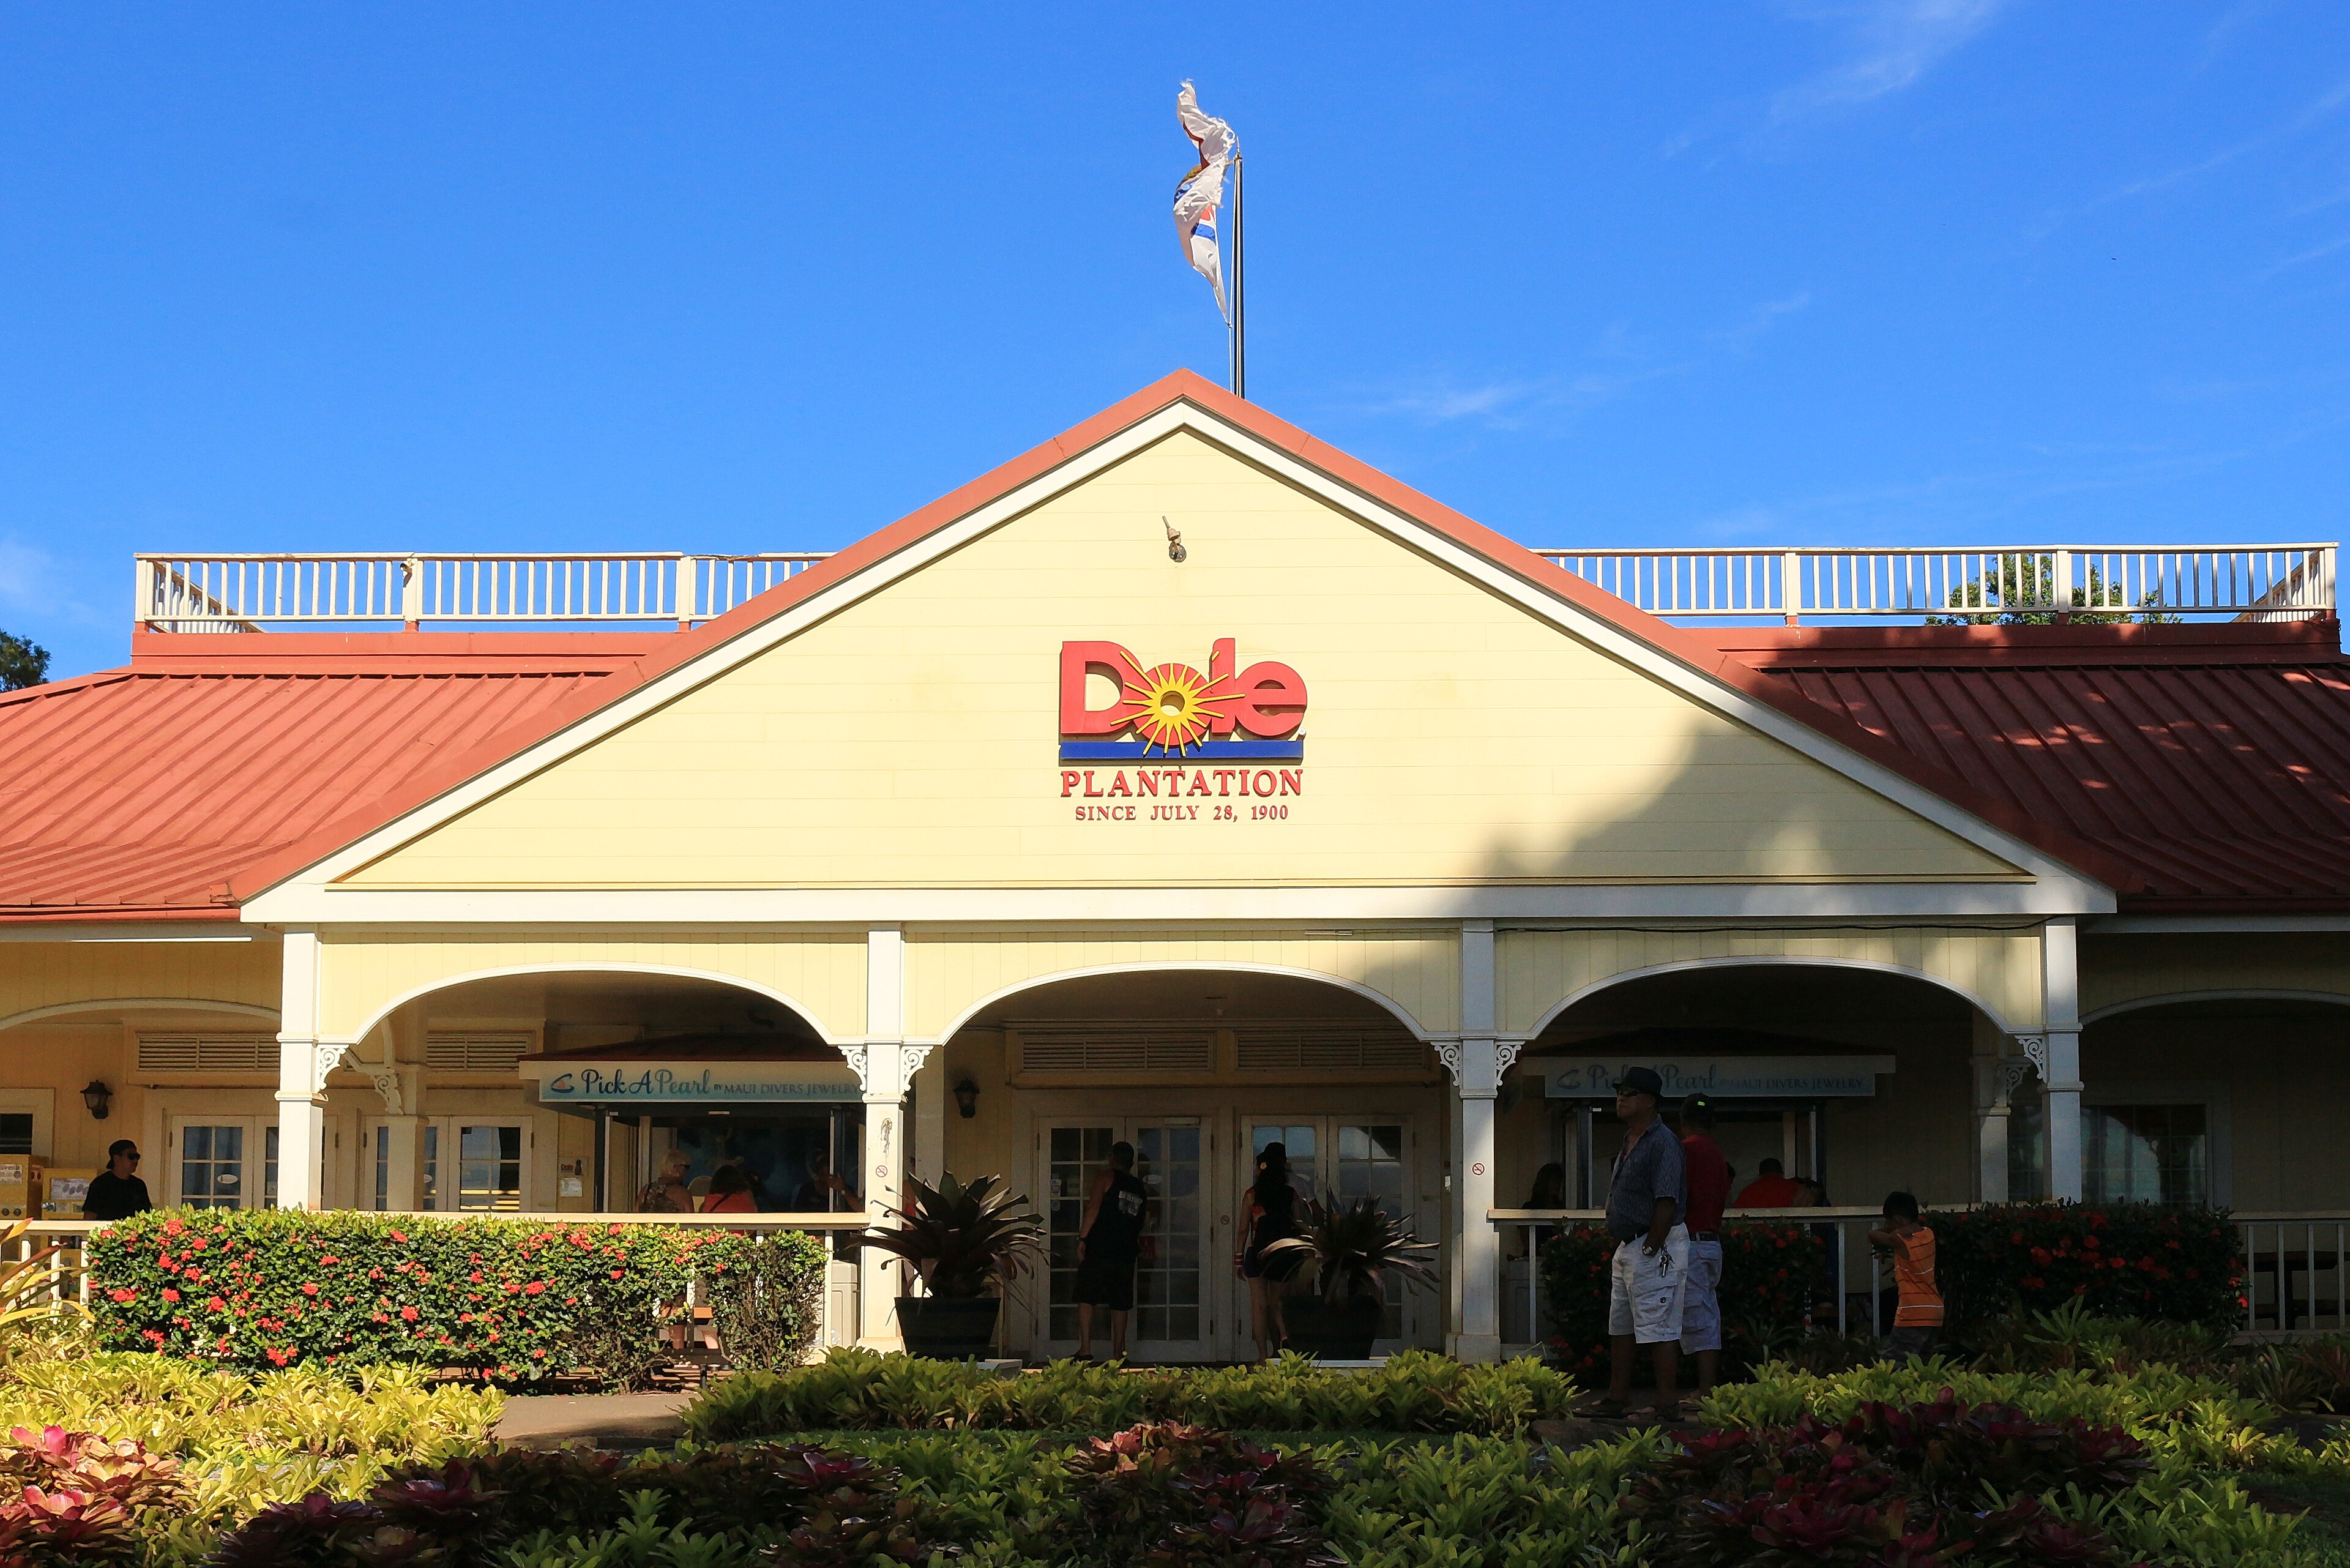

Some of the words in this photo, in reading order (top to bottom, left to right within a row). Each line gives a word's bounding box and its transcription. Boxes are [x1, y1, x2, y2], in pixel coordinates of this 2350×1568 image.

[1060, 637, 1307, 745] Dole
[1061, 769, 1304, 797] PLANTATION
[1075, 806, 1136, 821] SINCE
[1151, 805, 1199, 821] JULY
[1213, 805, 1239, 823] 28,
[1251, 805, 1289, 820] 1900
[581, 1069, 627, 1094] Pick
[629, 1069, 653, 1094] A
[655, 1069, 711, 1094] Pearl
[724, 1084, 756, 1094] MAUI
[761, 1084, 804, 1094] DIVERS
[808, 1083, 859, 1094] JEWELRY
[1661, 1064, 1717, 1089] Pearl
[1766, 1078, 1808, 1088] DIVERS
[1813, 1078, 1863, 1089] JEWELRY
